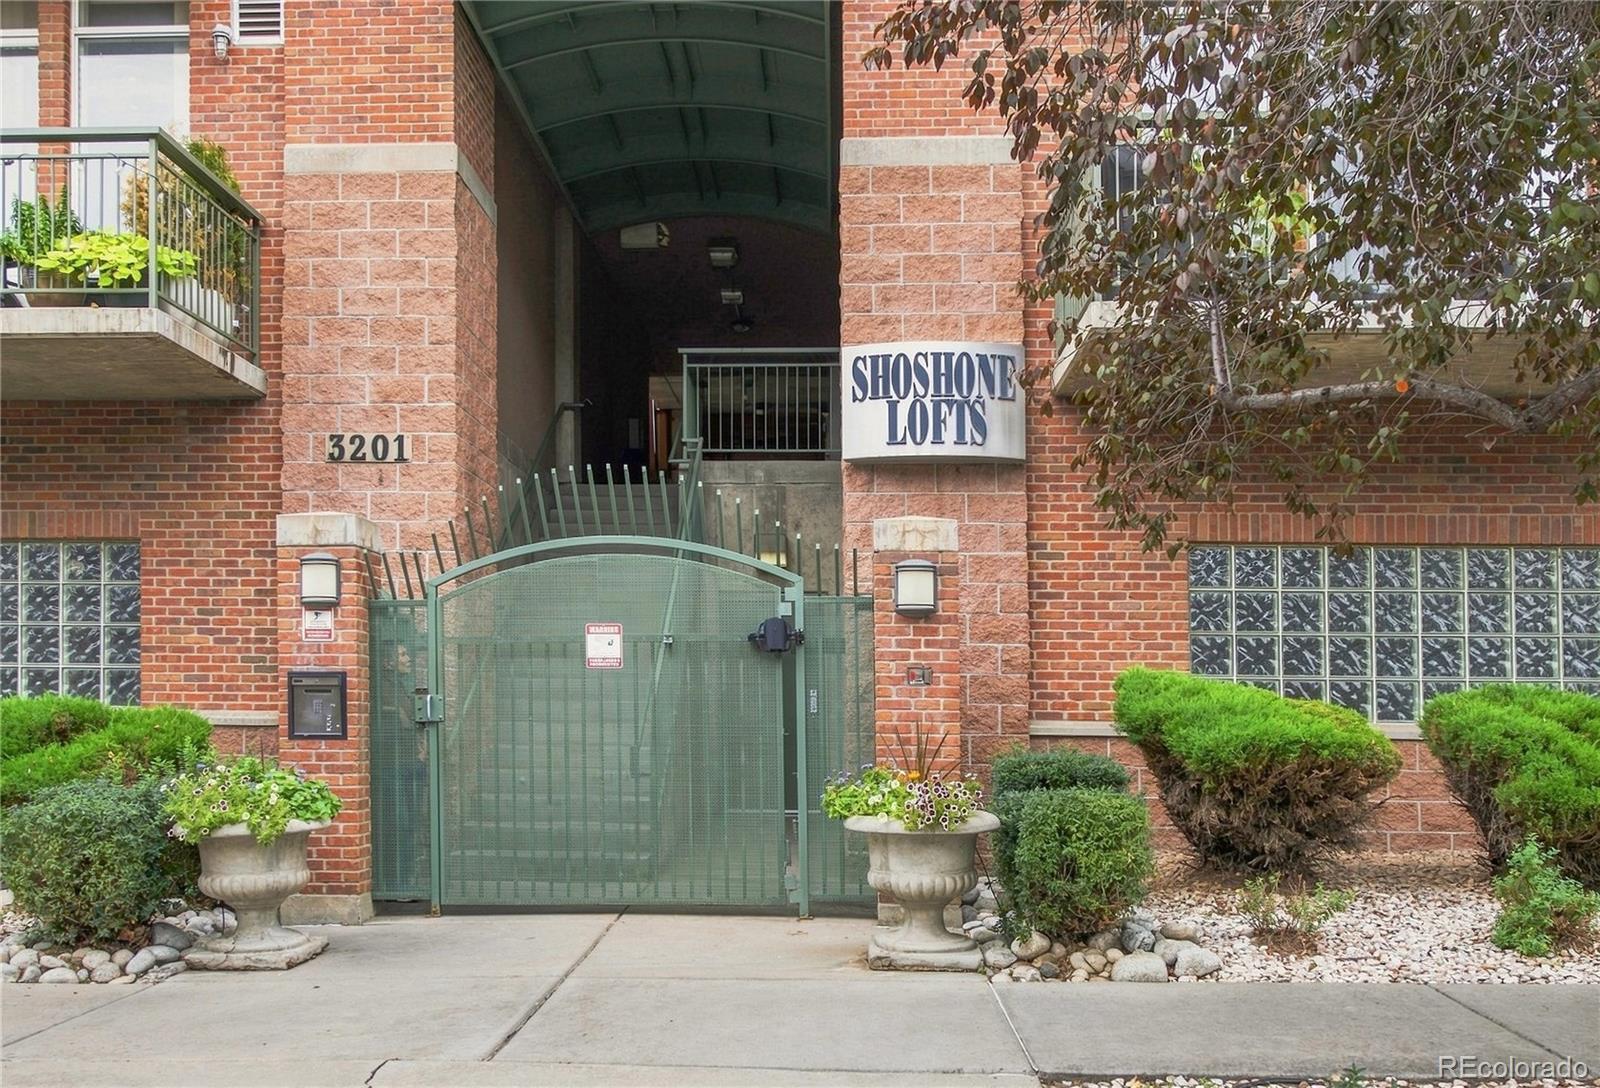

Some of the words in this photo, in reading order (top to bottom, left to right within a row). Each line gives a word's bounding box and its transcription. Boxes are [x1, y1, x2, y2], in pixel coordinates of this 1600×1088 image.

[852, 352, 1016, 402] SHOSHONE
[886, 398, 987, 446] LOFTS
[328, 434, 409, 461] 3201
